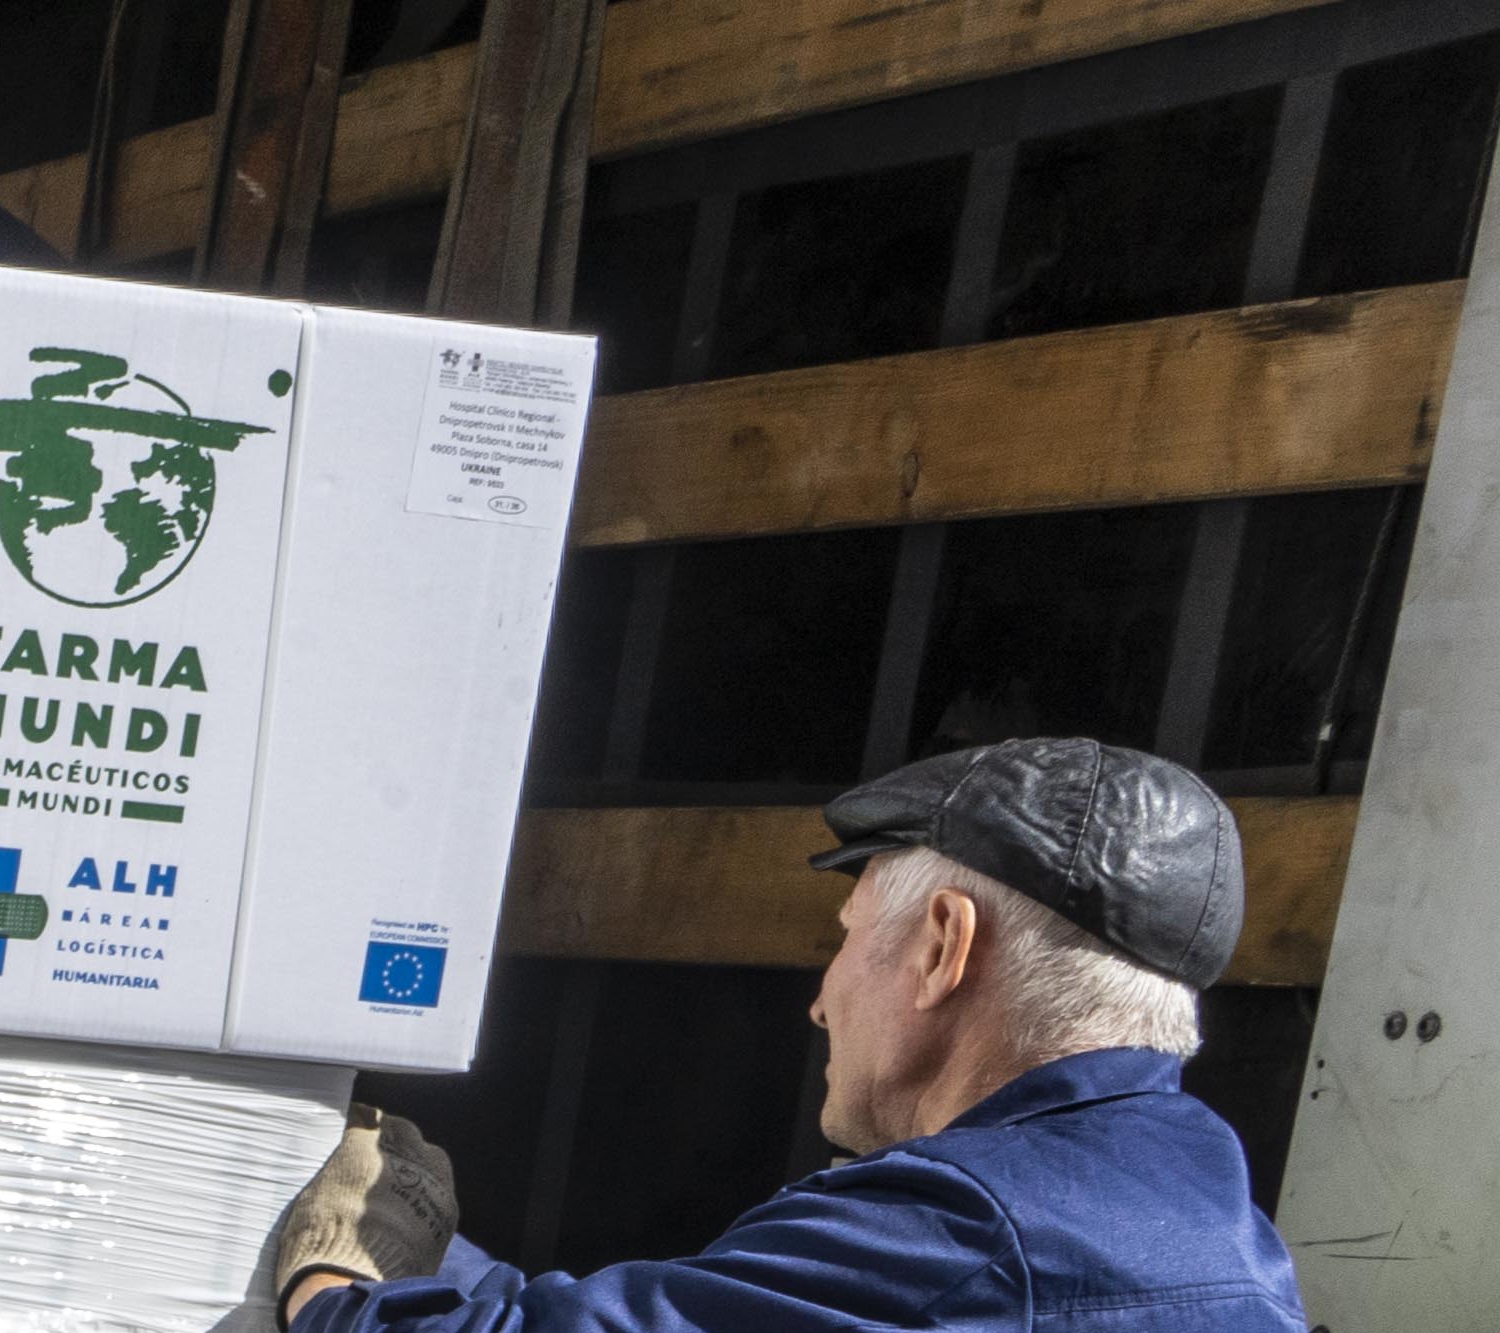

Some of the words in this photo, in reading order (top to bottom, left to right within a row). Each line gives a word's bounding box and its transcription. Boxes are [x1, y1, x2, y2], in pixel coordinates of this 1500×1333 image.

[450, 402, 485, 416] Hospital
[518, 410, 555, 424] Regional
[439, 415, 505, 433] Dnipropetrovsk
[451, 431, 473, 443] Plaza
[516, 442, 535, 451] casa
[538, 444, 547, 452] 14
[459, 447, 490, 460] Dnipro
[461, 463, 502, 476] UKRAINE
[17, 790, 112, 816] MUNDI
[67, 857, 178, 897] ALH
[80, 907, 151, 929] ÁREA
[417, 923, 438, 933] HPC
[57, 939, 164, 960] LOGÍSTICA
[52, 969, 159, 989] HUMANITARIA
